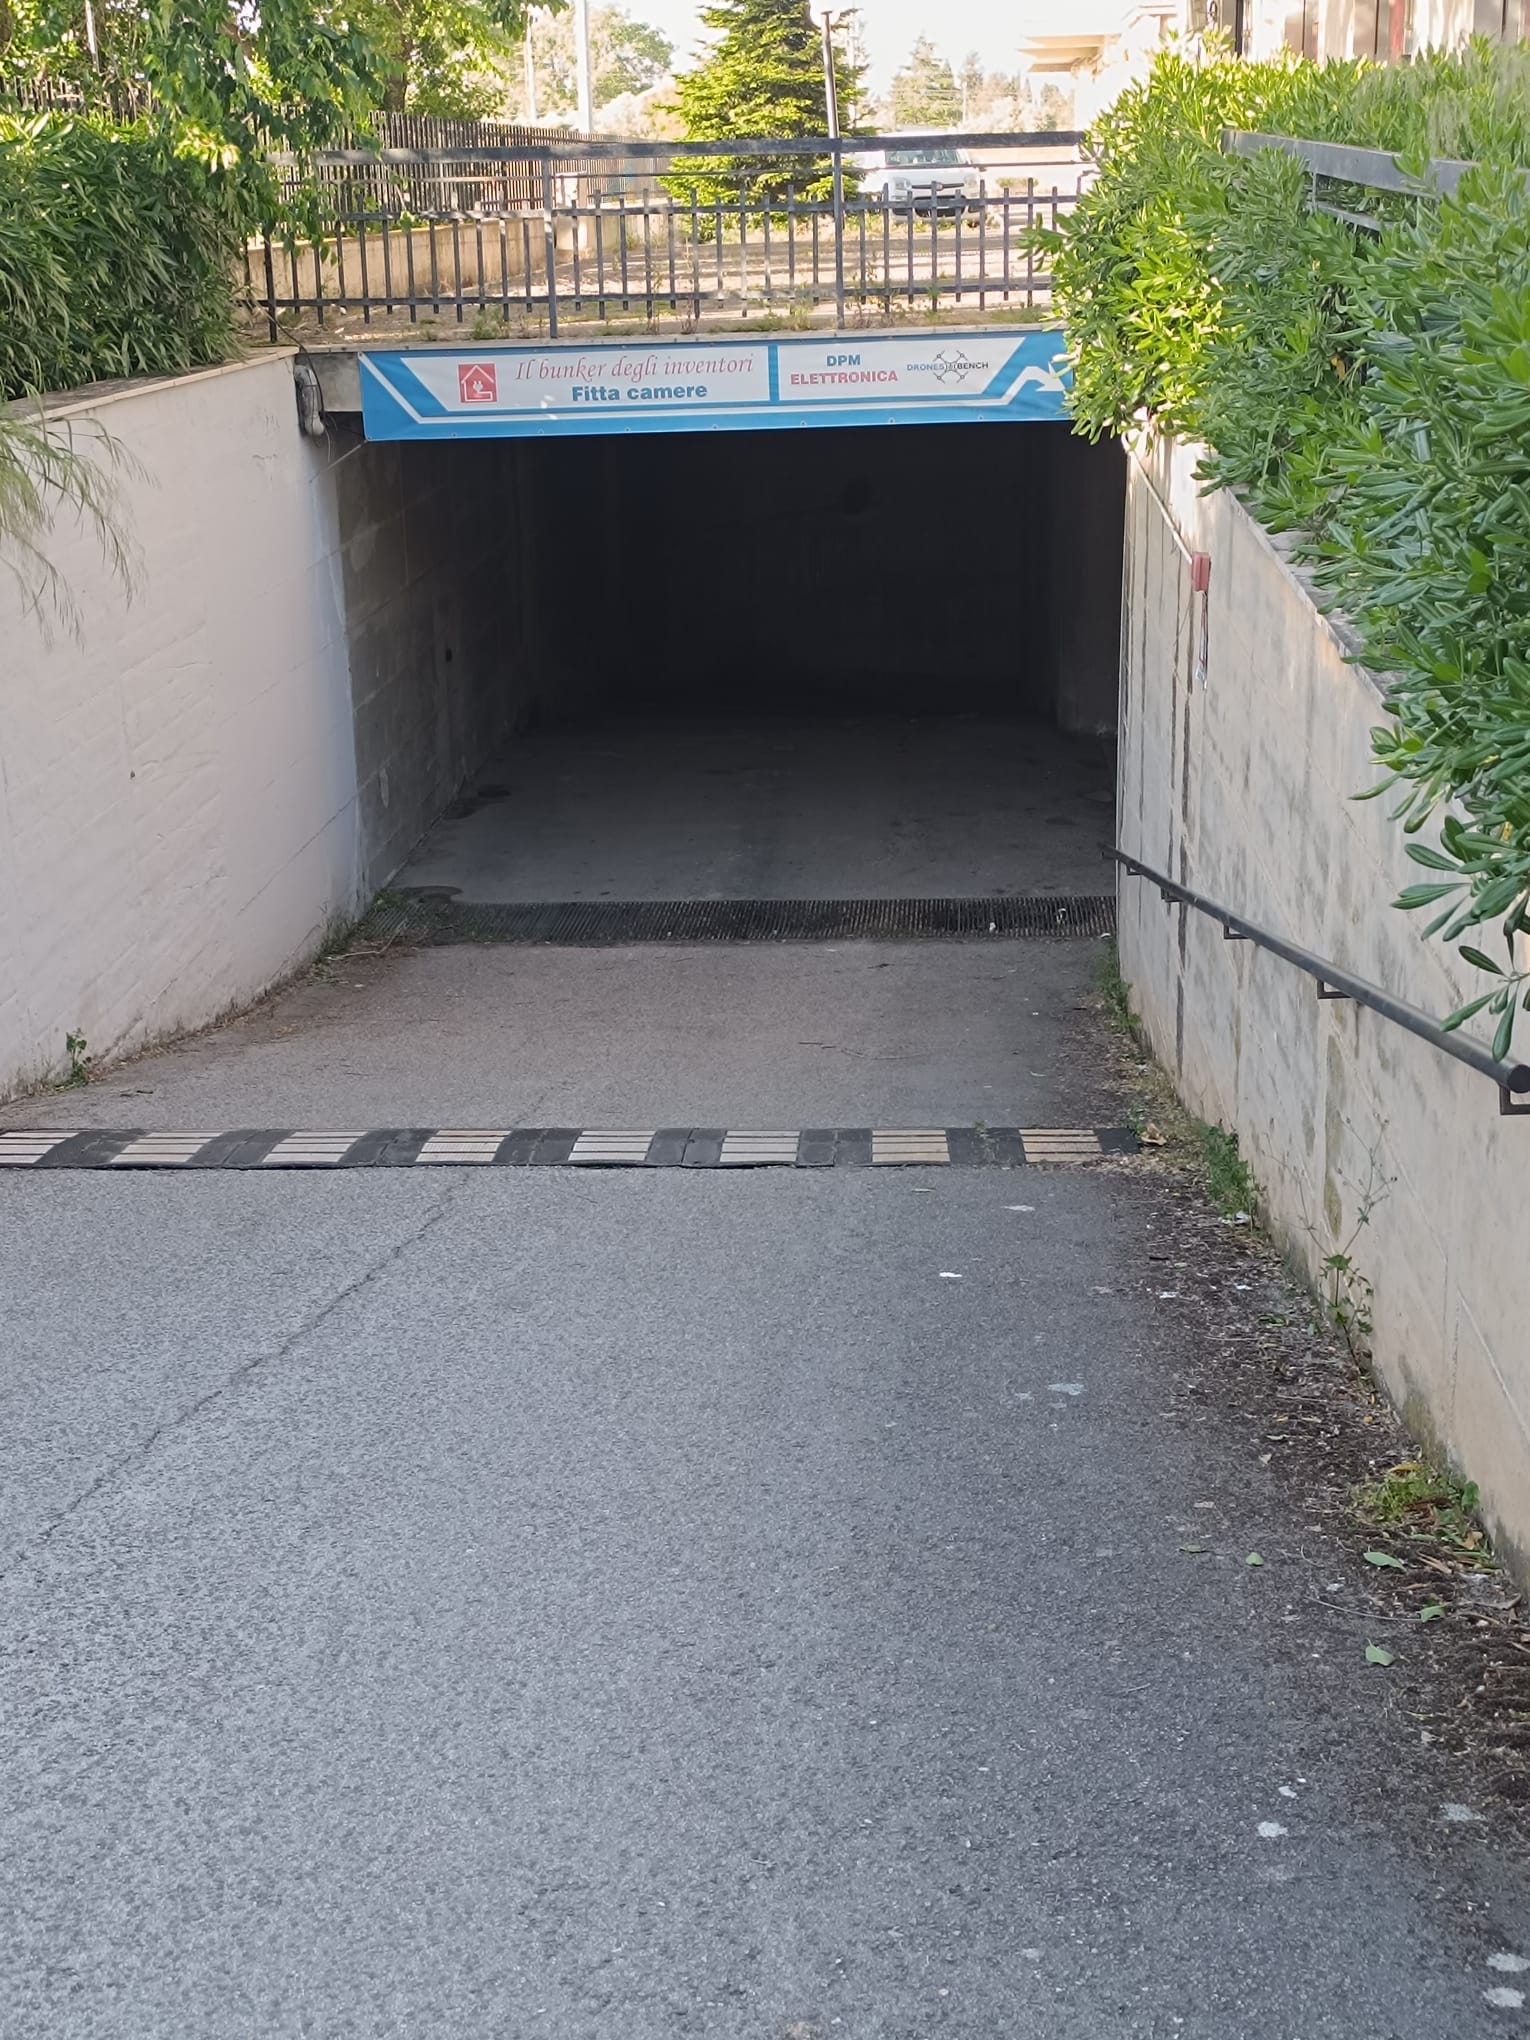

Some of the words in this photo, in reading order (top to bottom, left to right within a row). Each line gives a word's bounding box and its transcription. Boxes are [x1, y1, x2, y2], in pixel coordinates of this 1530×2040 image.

[516, 359, 535, 380] Il
[539, 357, 606, 382] bunker
[611, 355, 658, 382] degli
[664, 353, 754, 376] inventori
[827, 354, 861, 367] DPM
[907, 363, 945, 371] DRONES
[957, 362, 989, 370] BENCH
[790, 370, 898, 385] ELETTRONICA
[572, 385, 620, 401] Fitta
[627, 385, 708, 400] camere
